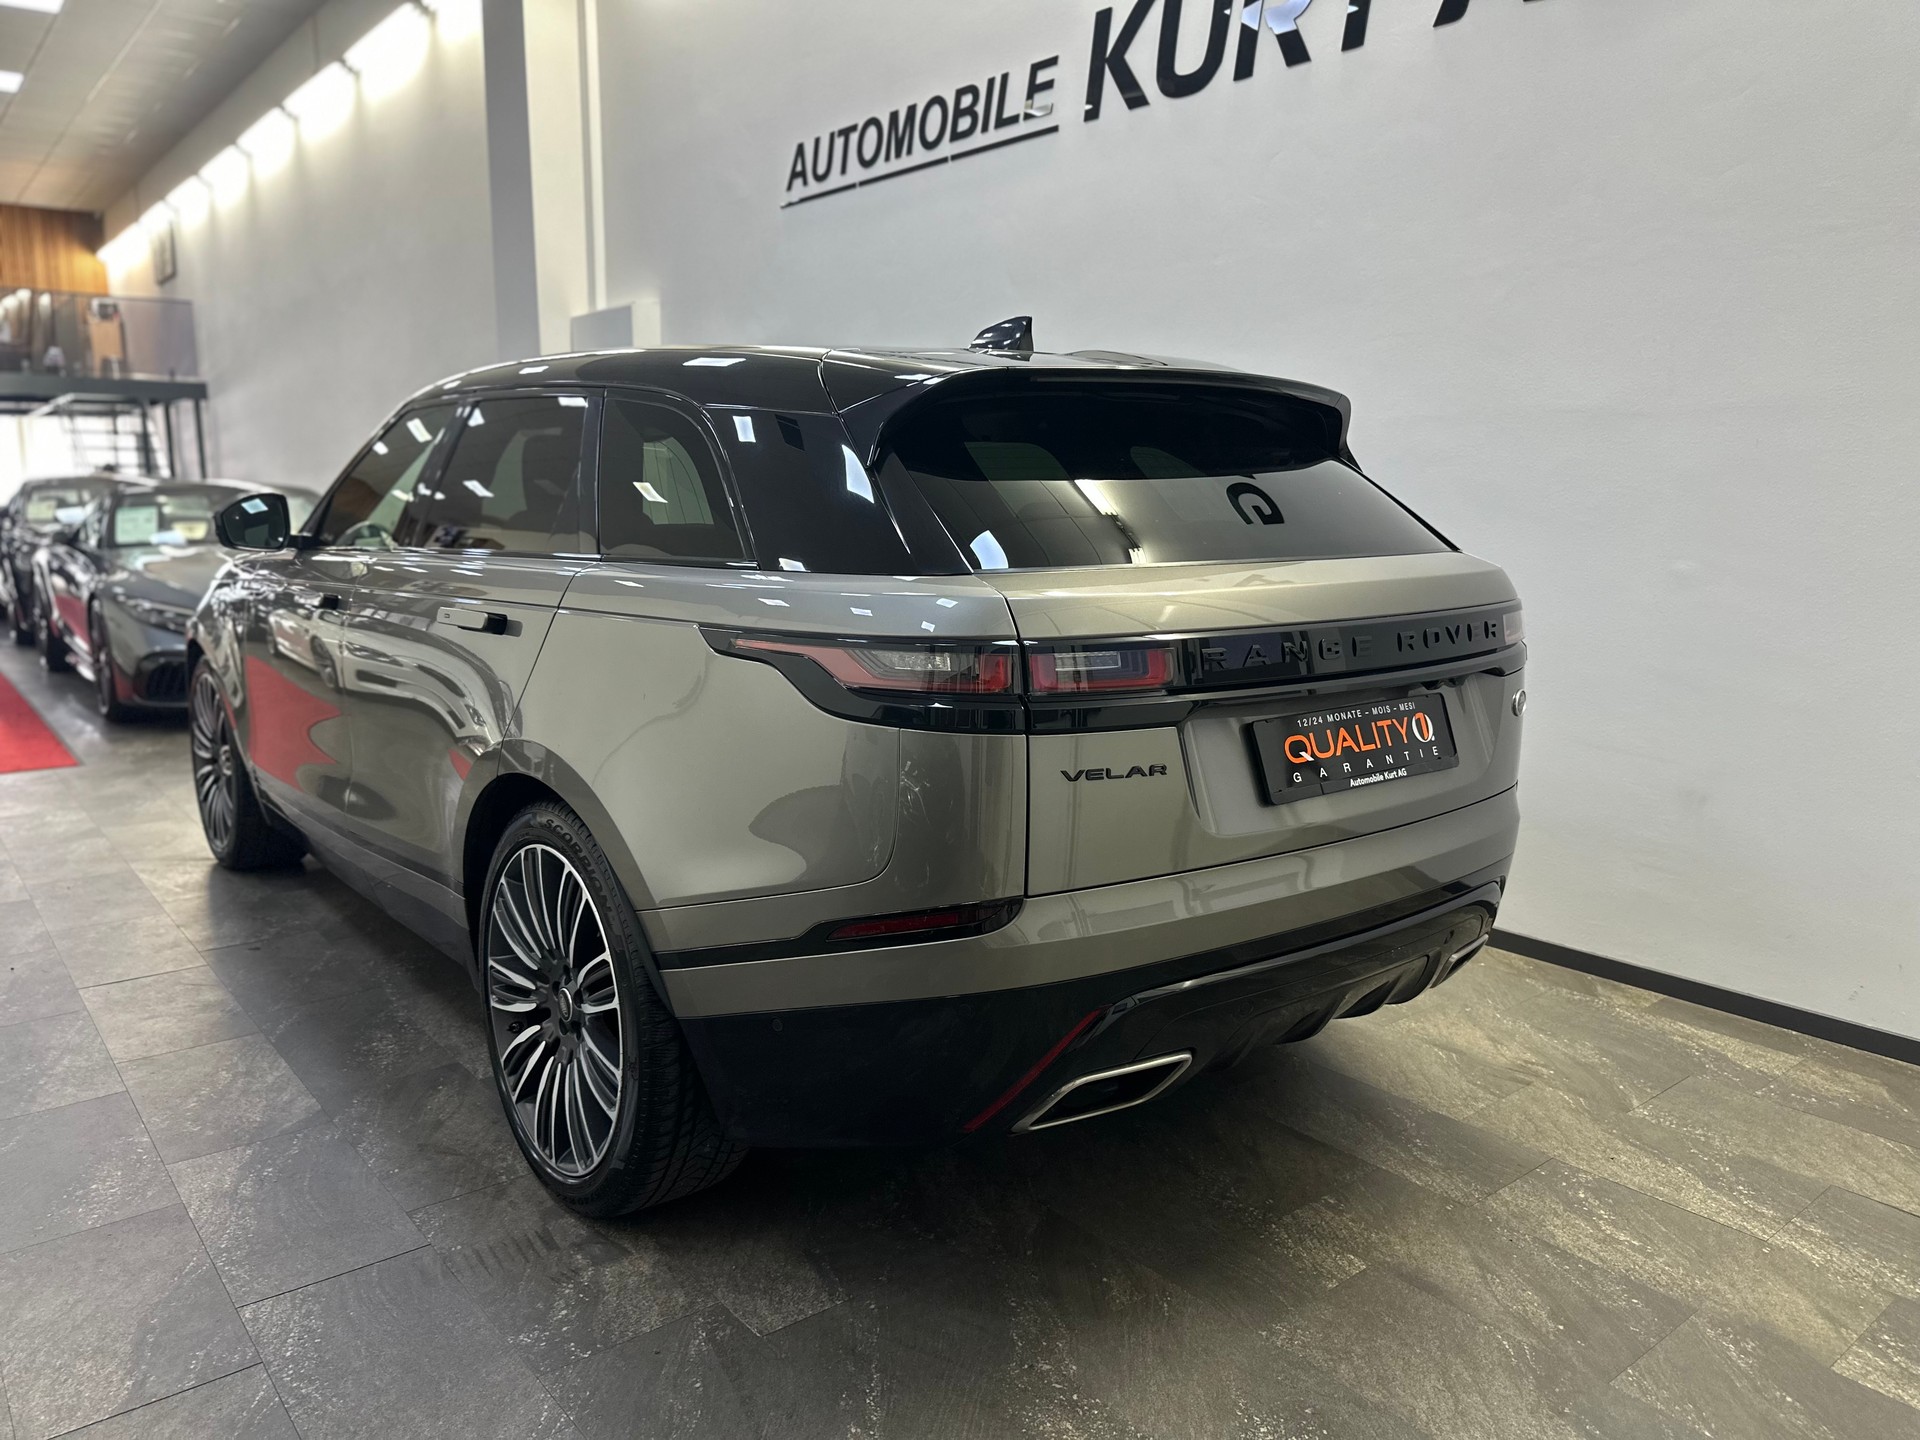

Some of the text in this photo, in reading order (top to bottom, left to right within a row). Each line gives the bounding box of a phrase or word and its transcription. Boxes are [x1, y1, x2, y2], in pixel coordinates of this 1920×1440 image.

[785, 54, 1060, 193] AUTOMOBILE
[1200, 618, 1499, 671] RANGE ROVER
[1297, 716, 1322, 728] 12/24
[1326, 709, 1363, 723] MONATE
[1371, 704, 1391, 716] MOIS
[1399, 701, 1416, 711] MESI
[1284, 716, 1409, 764] QUALITY
[1060, 764, 1168, 782] VELAR
[1293, 745, 1439, 783] GARANTIE
[1350, 767, 1408, 788] Automobile Kurt AG
